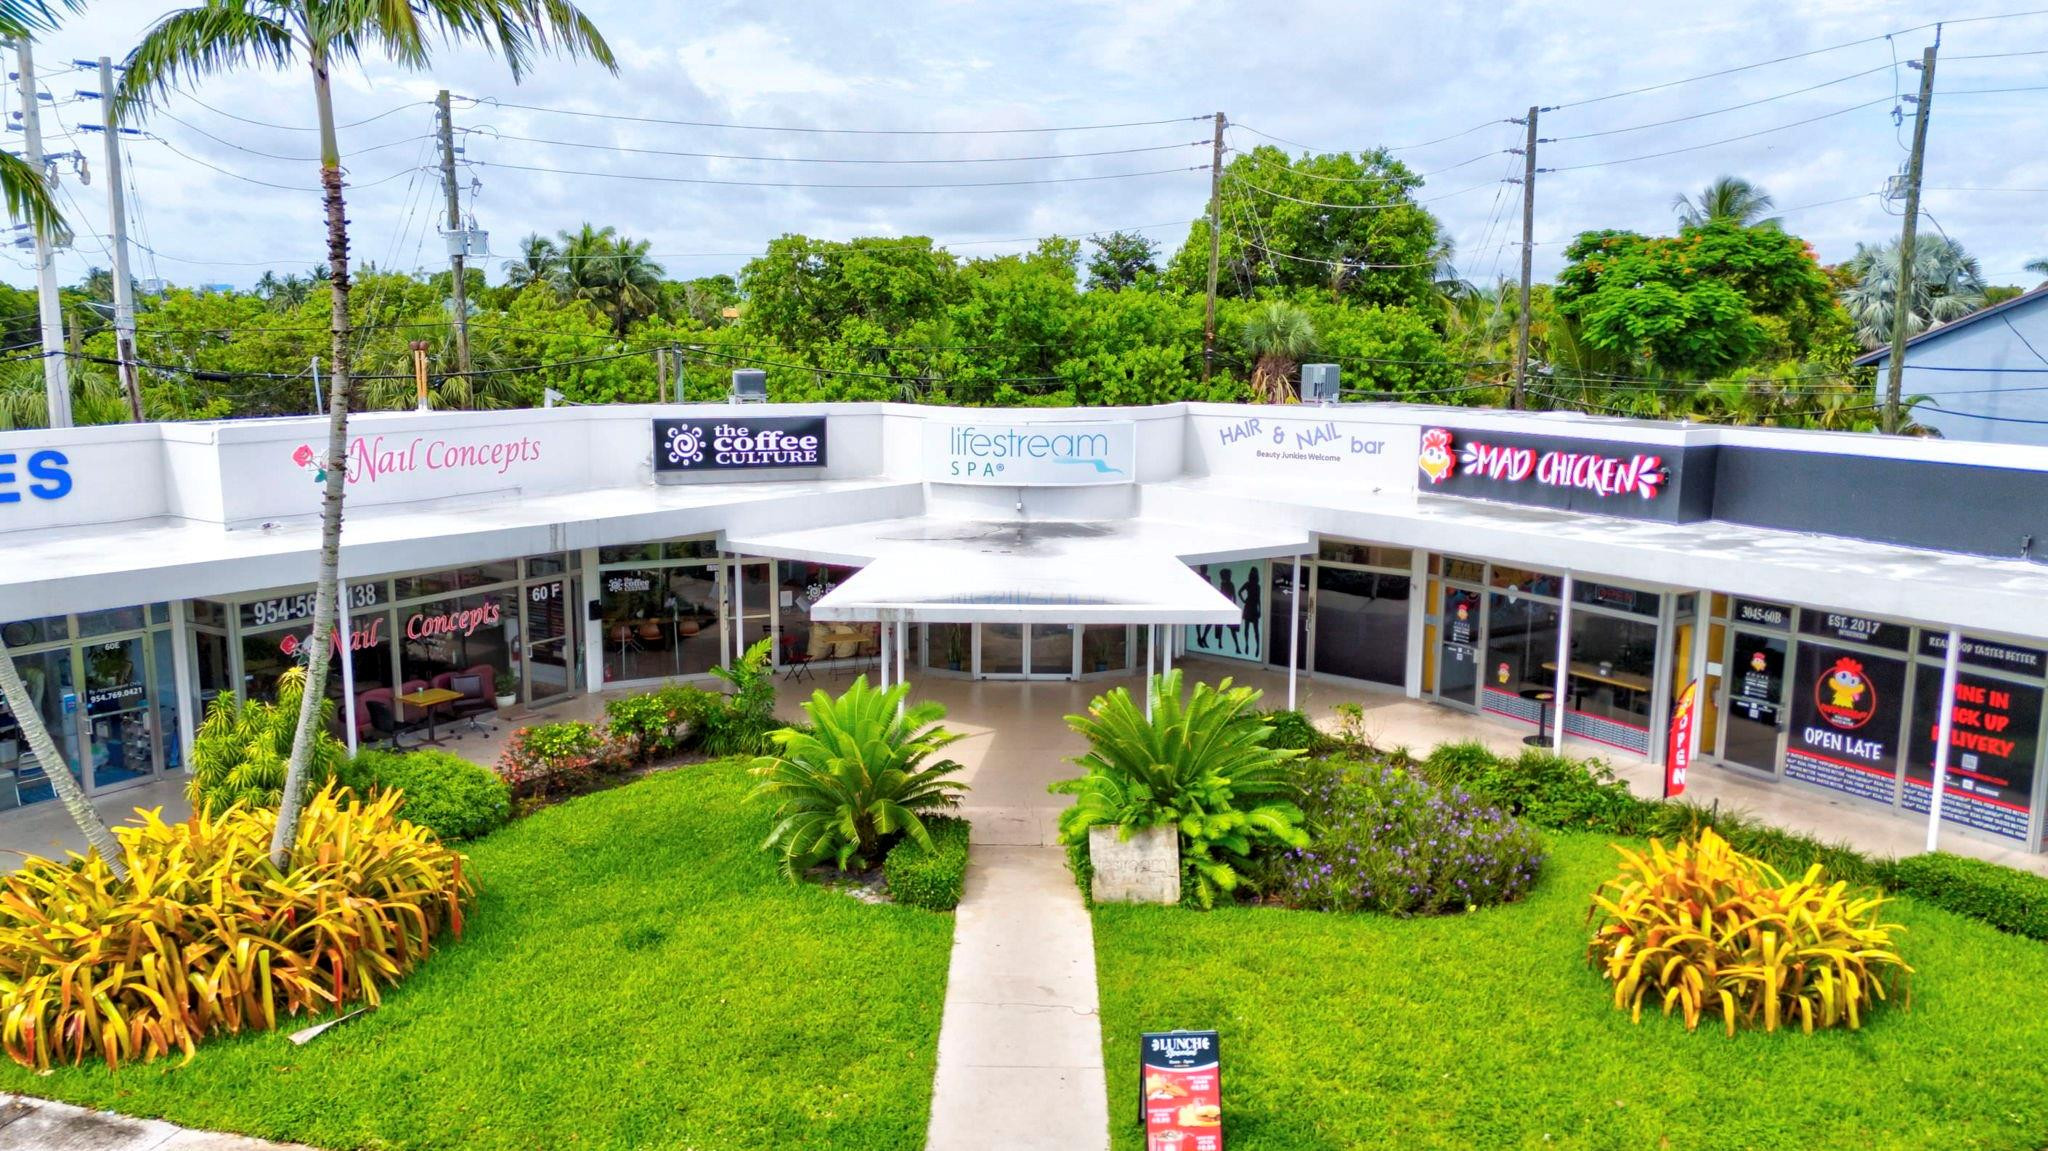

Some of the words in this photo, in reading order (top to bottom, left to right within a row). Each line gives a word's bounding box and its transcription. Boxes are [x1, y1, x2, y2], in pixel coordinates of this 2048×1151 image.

[713, 424, 749, 437] the
[1219, 418, 1262, 446] HAIR
[1273, 426, 1285, 444] &
[1296, 422, 1342, 450] NAIL
[1351, 436, 1385, 454] bar
[713, 431, 818, 451] coffee
[951, 426, 1108, 458] lifestream
[346, 436, 424, 484] Nail
[425, 436, 541, 474] Concepts
[715, 451, 818, 465] CULTURE
[1256, 449, 1282, 460] Beauty
[1282, 451, 1308, 461] Junkies
[1308, 453, 1341, 463] Welcome
[1476, 444, 1535, 482] MAD
[1537, 450, 1641, 497] CHICKEN
[532, 587, 549, 602] 60
[551, 583, 561, 599] F
[406, 601, 500, 640] Concepts
[1741, 606, 1782, 624] 3045-60B
[1827, 614, 1848, 629] EST.
[1850, 618, 1881, 634] 2017
[1974, 645, 2004, 659] TASTES
[2005, 650, 2037, 665] BETTER
[1989, 690, 2010, 710] IN
[1952, 706, 1981, 728] ICK
[1983, 713, 2010, 732] UP
[1672, 714, 1689, 785] OPEN
[1804, 727, 1842, 751] OPEN
[1846, 737, 1882, 760] LATE
[1160, 1037, 1202, 1051] LUNCH
